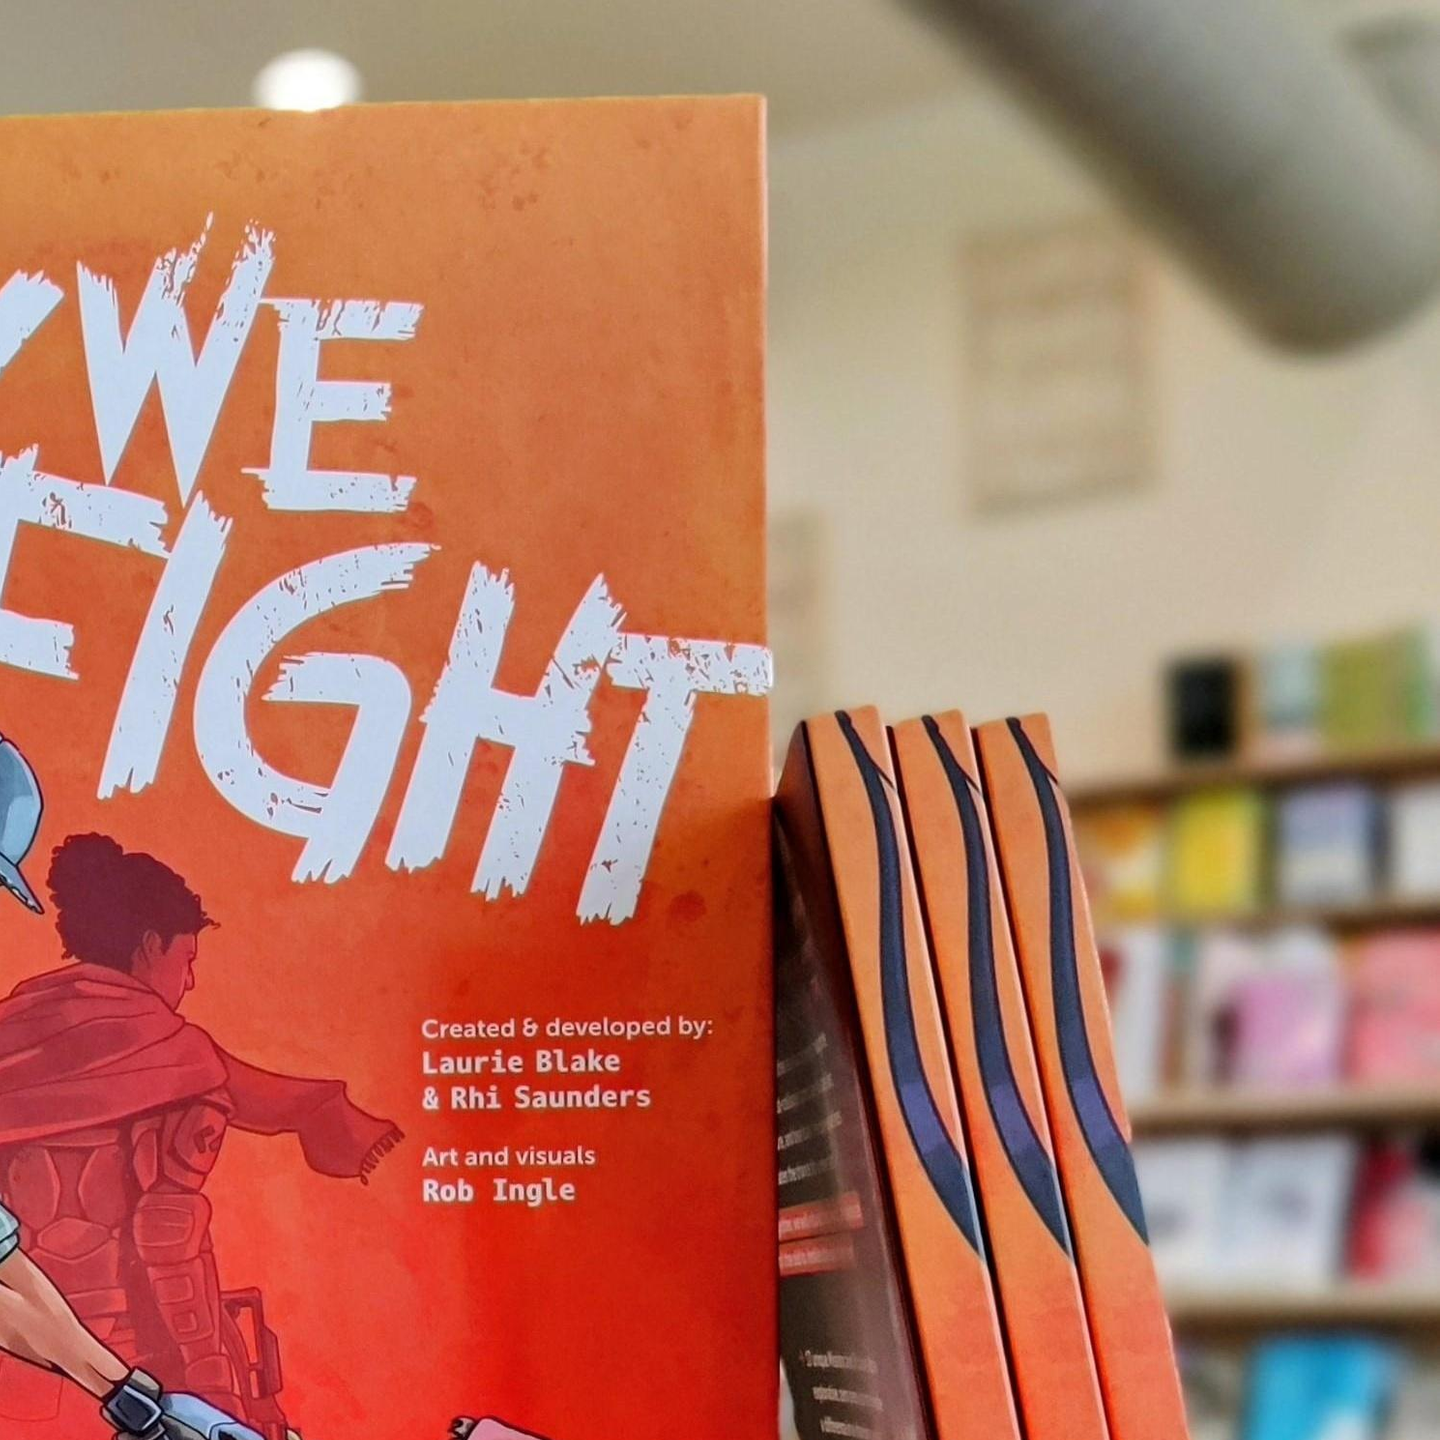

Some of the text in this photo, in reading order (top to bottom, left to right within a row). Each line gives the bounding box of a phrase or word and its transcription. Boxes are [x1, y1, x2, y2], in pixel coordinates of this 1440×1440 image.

[77, 213, 423, 511] WE
[421, 1016, 713, 1040] Created & developed by:
[421, 1049, 621, 1074] Laurie Blake
[421, 1085, 651, 1109] & Rhi Saunders
[422, 1145, 596, 1167] Art and visuals
[422, 1178, 575, 1207] Rob Ingle
